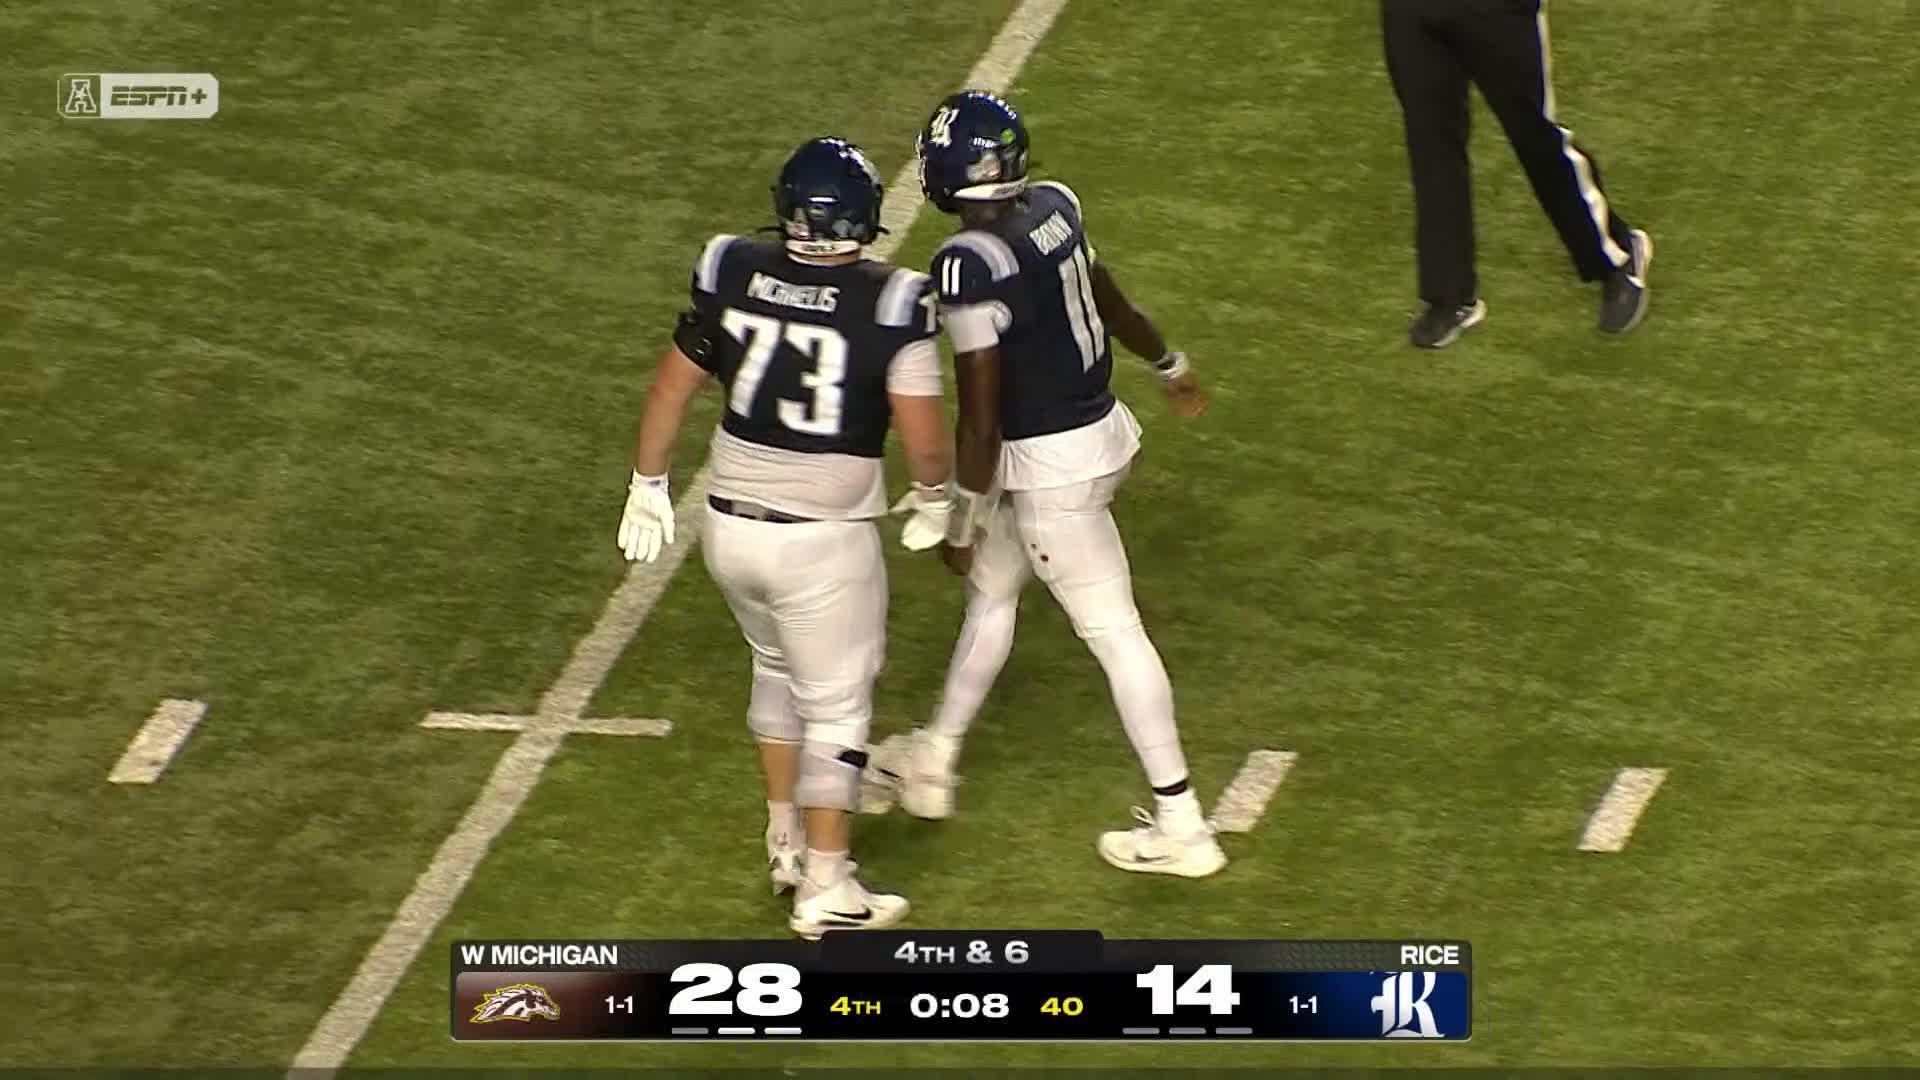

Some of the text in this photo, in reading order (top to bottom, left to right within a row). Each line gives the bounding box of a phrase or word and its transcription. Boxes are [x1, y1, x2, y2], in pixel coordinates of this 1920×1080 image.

[941, 256, 962, 295] 11
[1058, 244, 1105, 374] 11
[721, 307, 849, 436] 73
